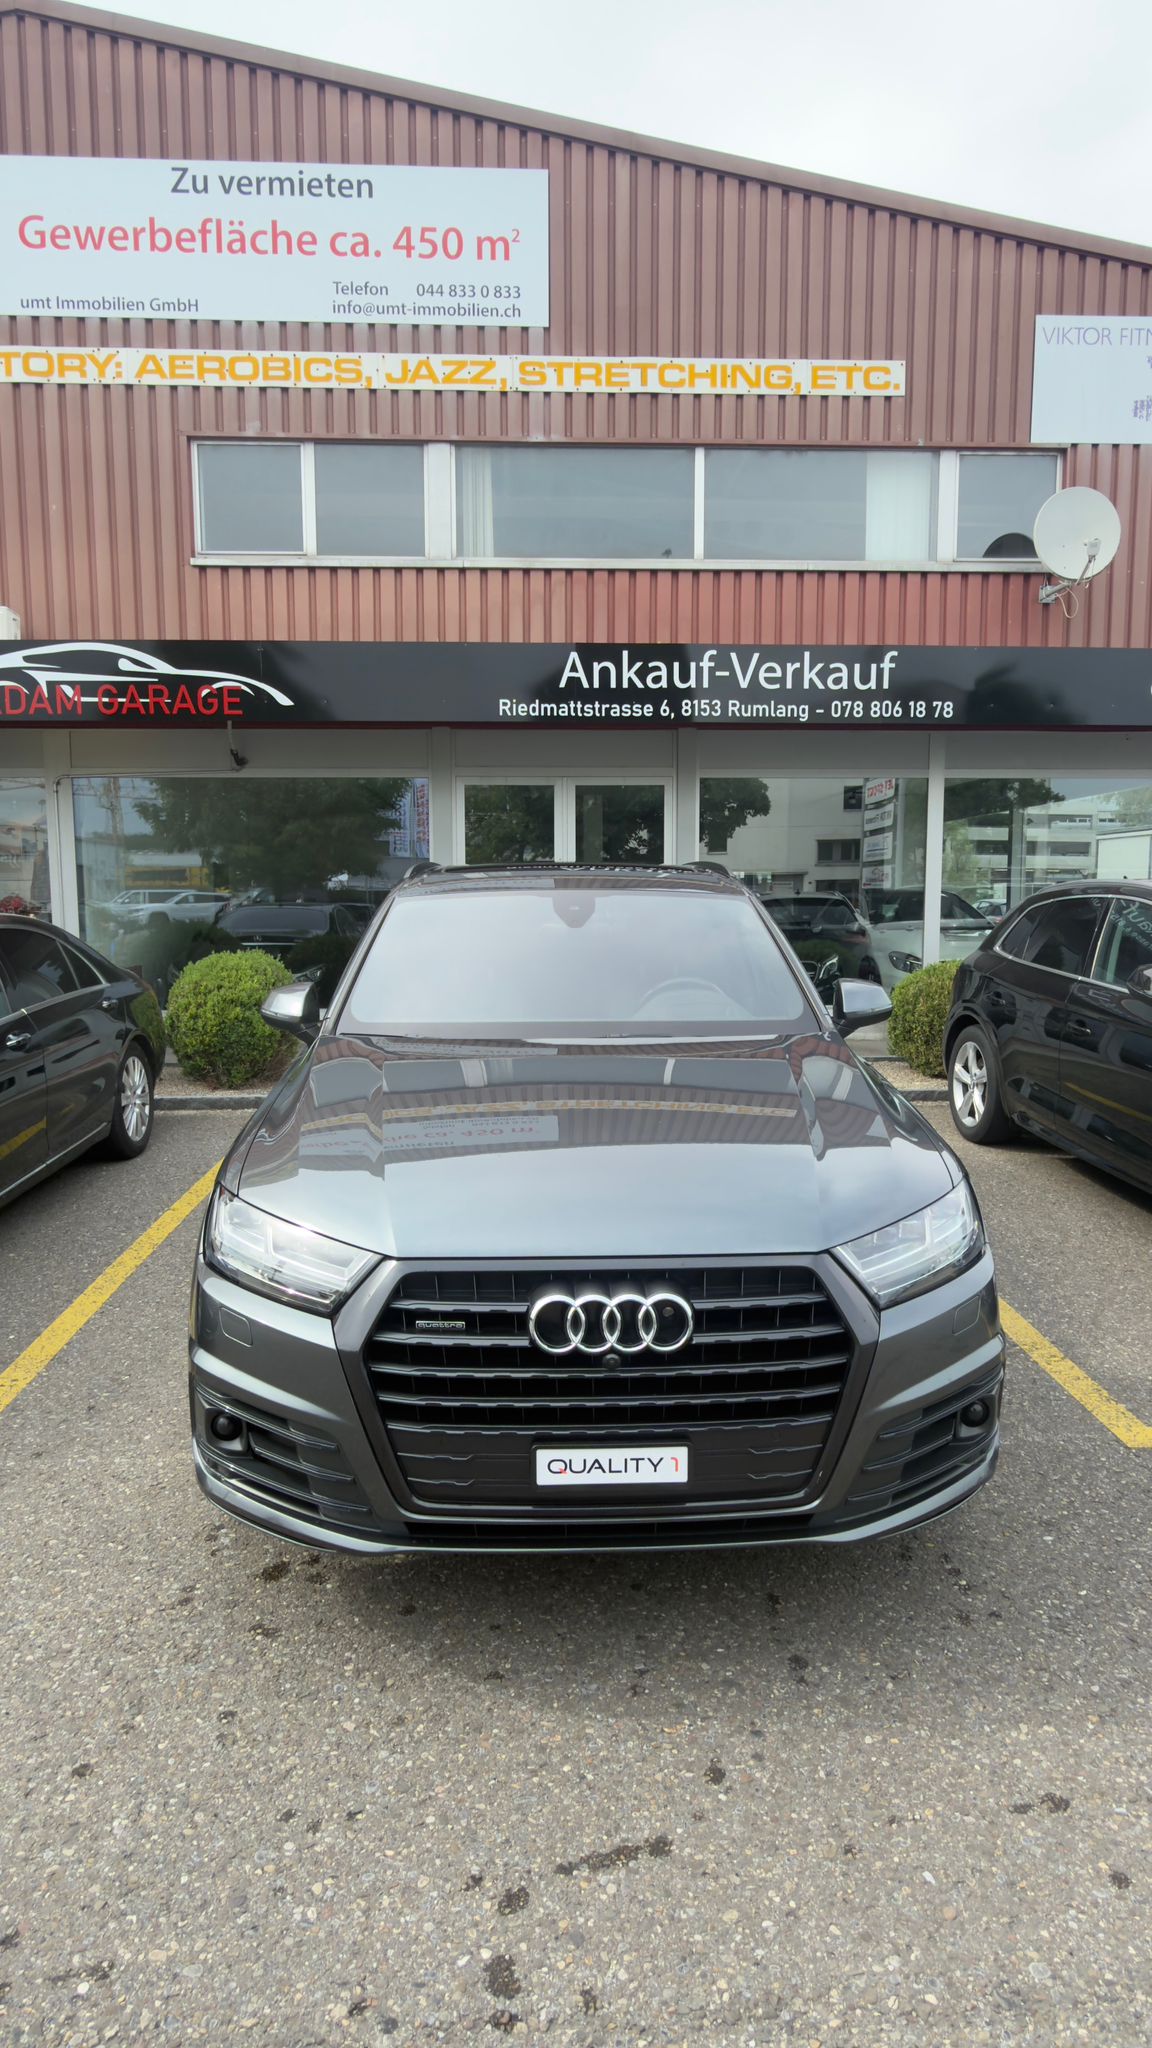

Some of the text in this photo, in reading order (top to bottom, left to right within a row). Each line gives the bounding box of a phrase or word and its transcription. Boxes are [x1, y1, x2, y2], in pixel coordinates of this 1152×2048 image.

[170, 166, 374, 199] Zu vermieten
[18, 214, 319, 257] Gewerbefläche
[329, 232, 382, 258] ca.
[392, 226, 465, 260] 450
[333, 281, 521, 299] Telefon 044 833 0 833
[20, 295, 199, 312] umt Immobilien GmbH
[332, 300, 521, 318] info@umt-immobilien.ch
[1043, 327, 1112, 346] VIKTOR
[135, 354, 373, 388] AEROBICS,
[386, 359, 507, 391] JAZZ,
[519, 361, 802, 395] STRETCHING,
[810, 365, 900, 391] ETC.
[559, 649, 899, 692] Ankauf-Verkauf
[0, 685, 243, 716] DAM GARAGE
[498, 698, 654, 717] Riedmattstrasse
[660, 699, 675, 719] 6,
[681, 699, 722, 717] 8153
[728, 700, 809, 721] Rumlang
[831, 701, 864, 718] 078
[870, 701, 903, 718] 806
[908, 701, 927, 718] 18
[932, 701, 954, 719] 78
[417, 1321, 464, 1330] quattro
[547, 1456, 679, 1474] QUALITY 1
